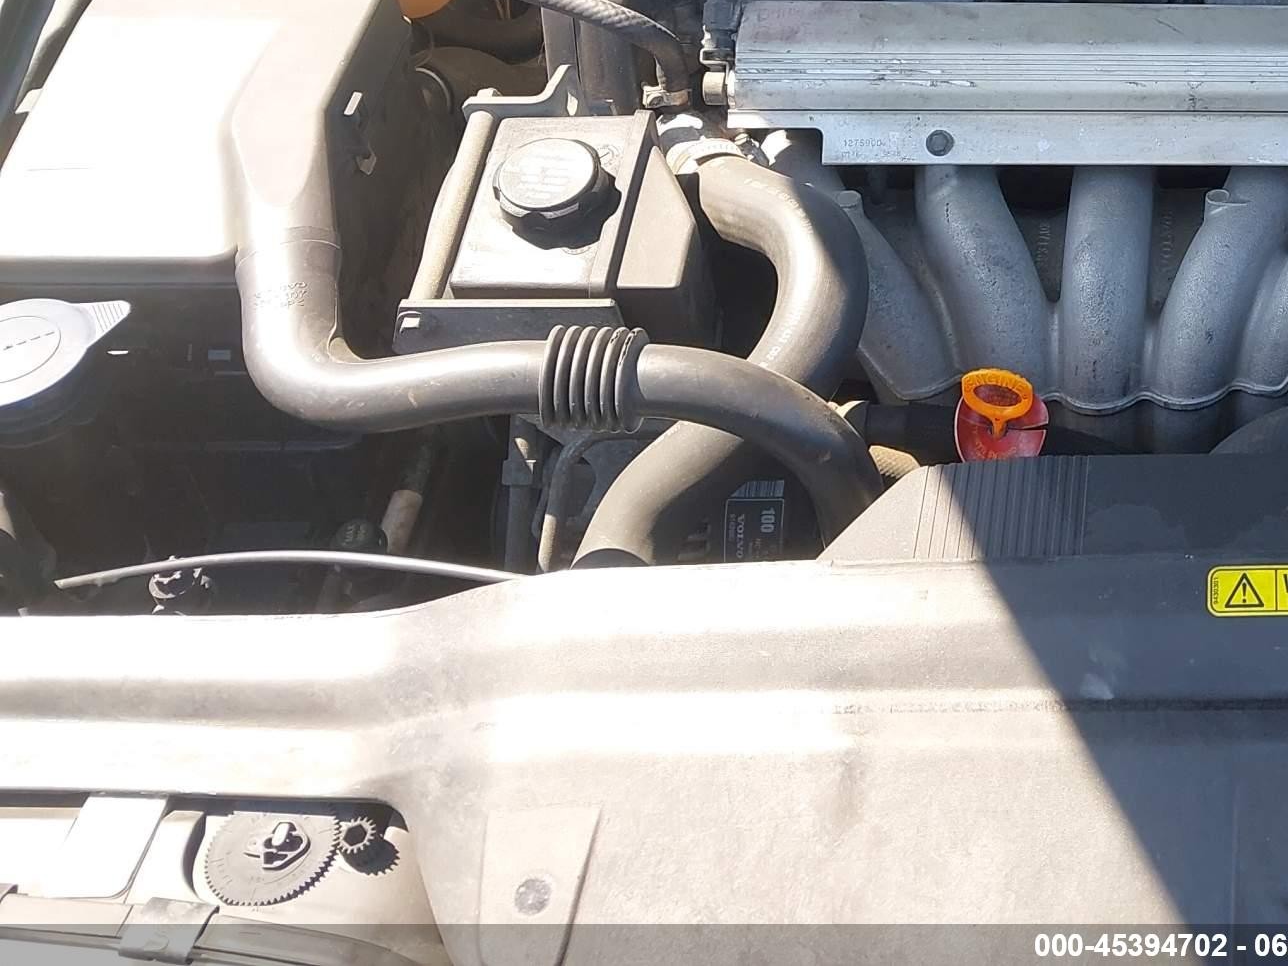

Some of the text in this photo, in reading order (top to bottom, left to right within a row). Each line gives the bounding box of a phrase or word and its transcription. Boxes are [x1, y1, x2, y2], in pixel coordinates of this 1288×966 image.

[964, 371, 1027, 393] ENGINE
[760, 507, 776, 533] 100
[735, 514, 745, 559] VOLVO
